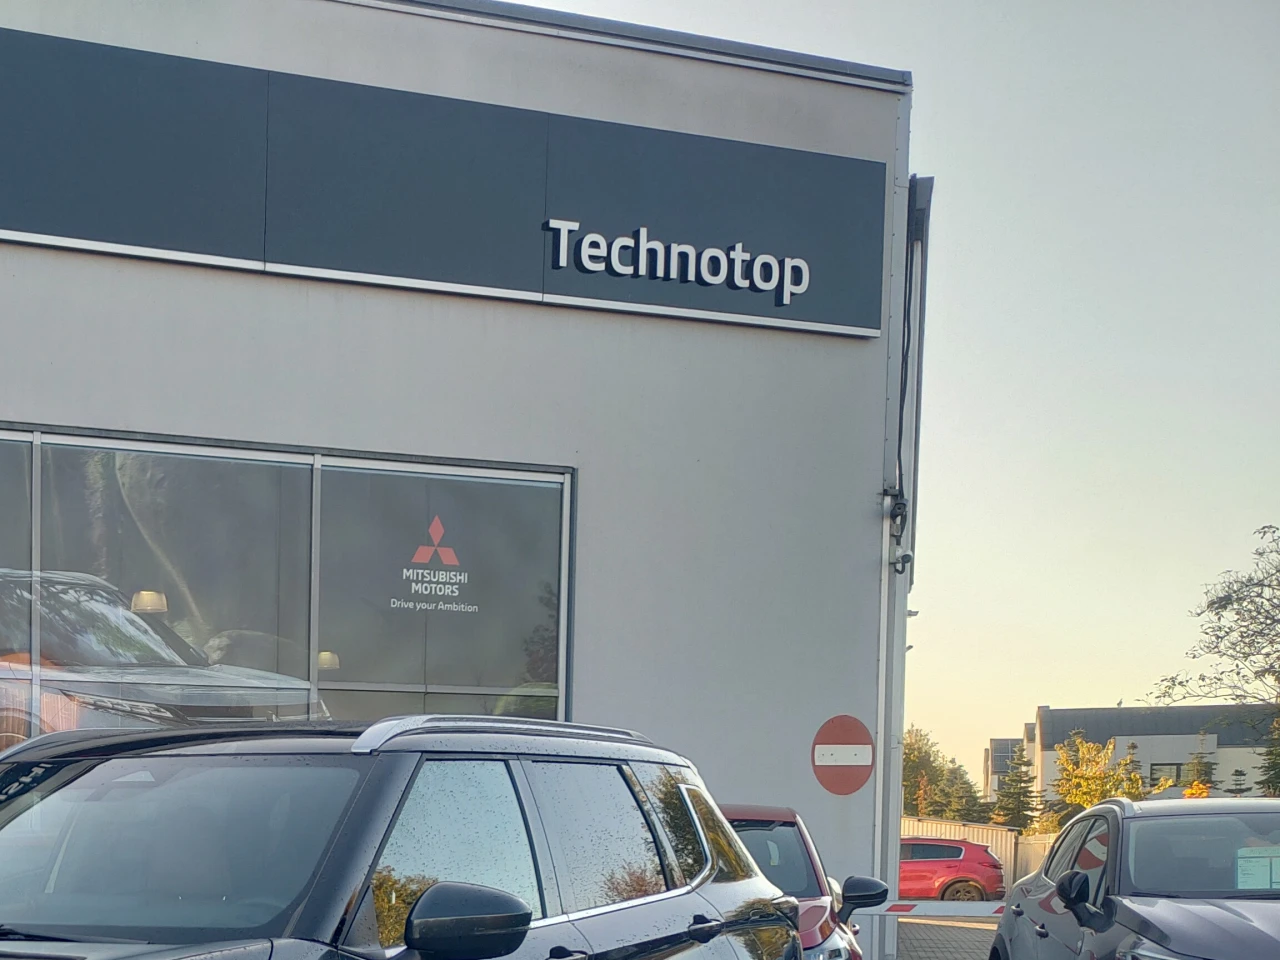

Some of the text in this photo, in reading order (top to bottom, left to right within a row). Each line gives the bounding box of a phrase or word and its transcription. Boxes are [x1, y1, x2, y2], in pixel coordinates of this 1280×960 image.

[545, 218, 811, 305] Technotop
[402, 568, 468, 583] MITSUBISHI
[411, 583, 459, 596] MOTORS
[390, 598, 479, 613] Drive your Ambition
